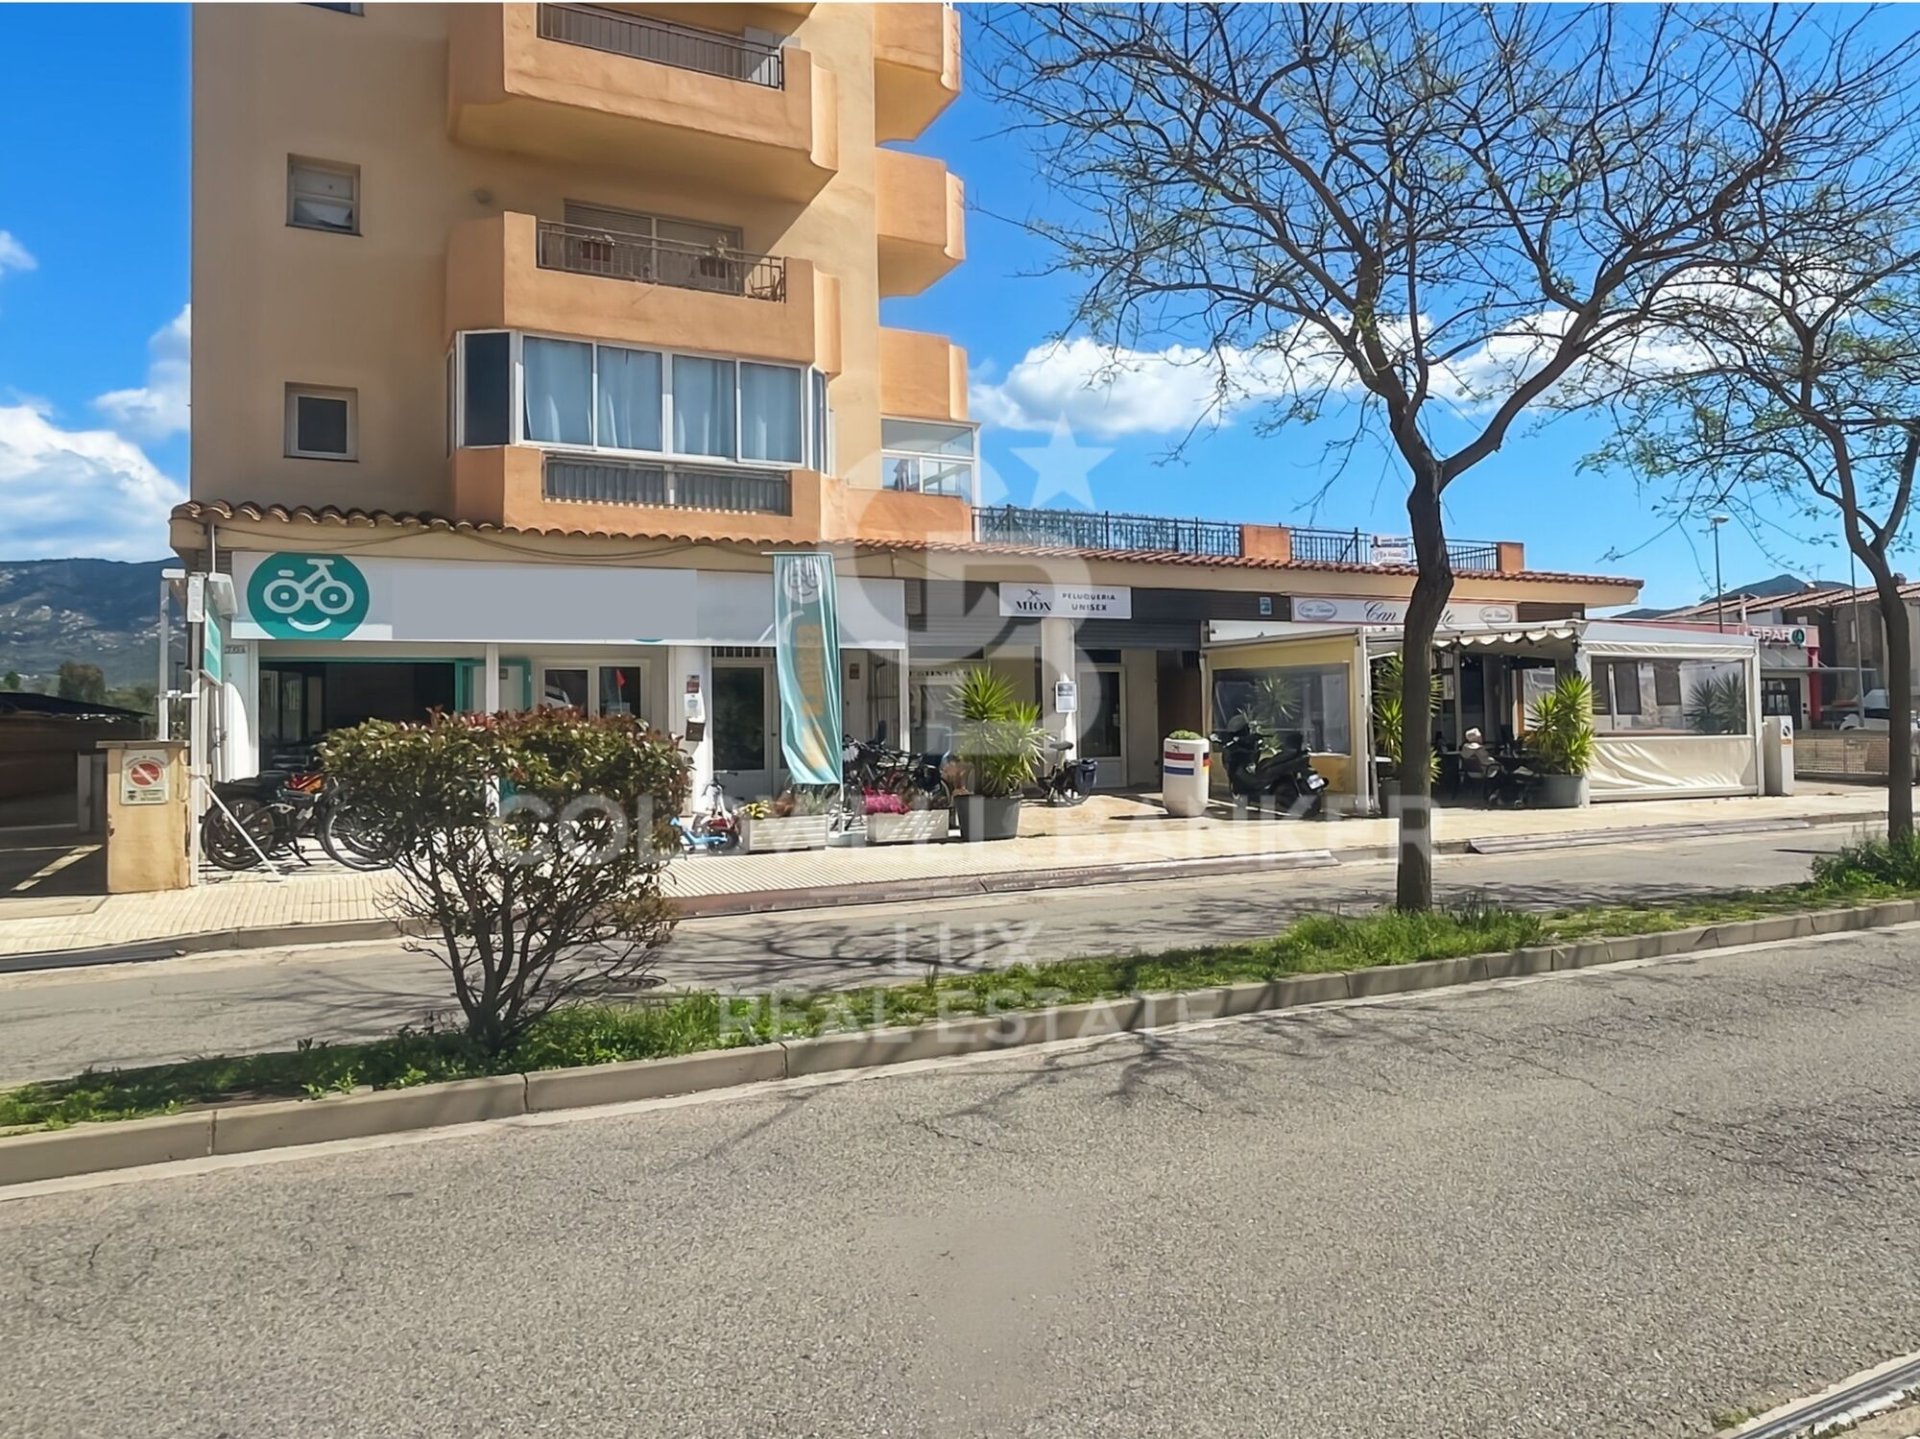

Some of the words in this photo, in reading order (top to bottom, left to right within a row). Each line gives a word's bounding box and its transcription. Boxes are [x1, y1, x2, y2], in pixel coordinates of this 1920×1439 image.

[1062, 592, 1116, 601] PELUQUERIA
[1071, 603, 1107, 612] UNISEX
[1363, 600, 1398, 622] Can
[1751, 627, 1791, 641] SPAR
